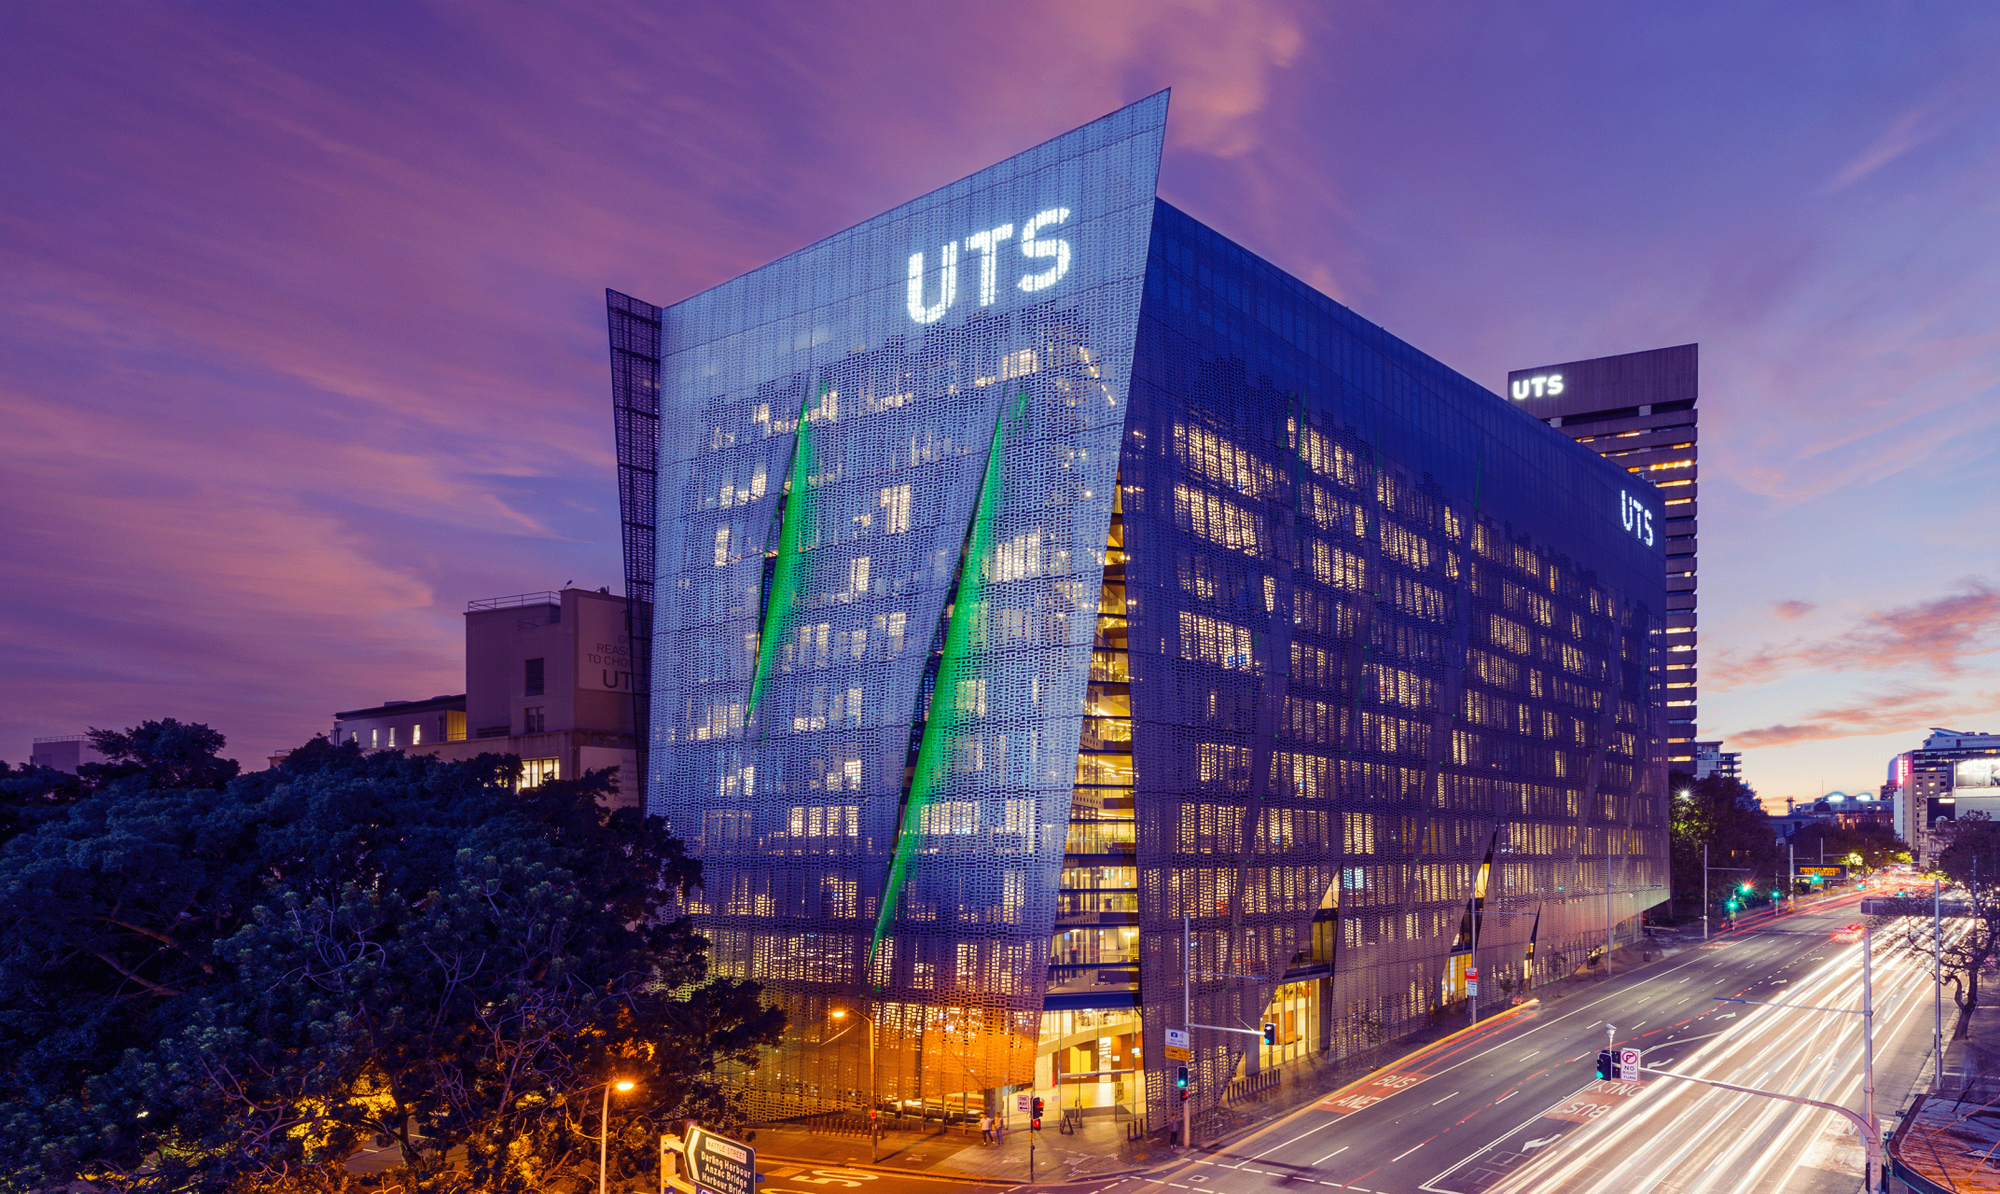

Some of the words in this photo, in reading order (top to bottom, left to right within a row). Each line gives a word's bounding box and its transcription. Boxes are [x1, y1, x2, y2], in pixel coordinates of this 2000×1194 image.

[907, 207, 1071, 324] UTS
[1512, 373, 1564, 400] UTS
[1621, 489, 1654, 547] UTS
[586, 653, 601, 664] TO
[1372, 1074, 1417, 1089] BUS
[1587, 1080, 1647, 1098] ONLY
[1320, 1093, 1382, 1109] LANE
[1562, 1101, 1613, 1118] BUS
[707, 1139, 726, 1154] WATTLE
[726, 1147, 746, 1161] STREET
[700, 1151, 724, 1168] Darling
[724, 1160, 752, 1179] Harbour
[704, 1163, 726, 1178] Anzac
[726, 1171, 748, 1189] Bridge
[701, 1172, 728, 1191] Harbour
[728, 1182, 749, 1194] Brid
[789, 1169, 880, 1188] 50
